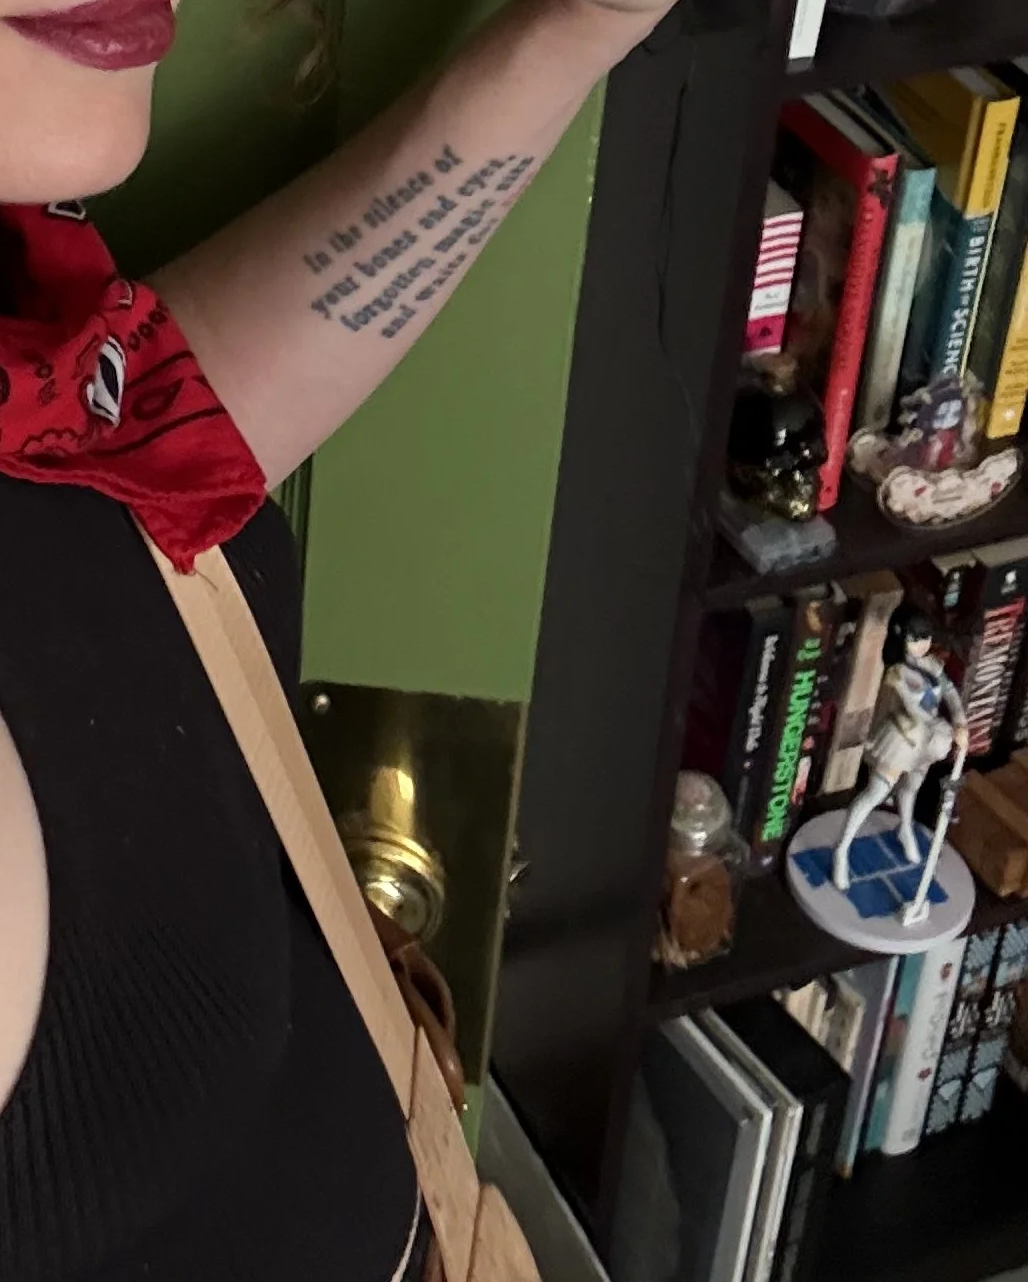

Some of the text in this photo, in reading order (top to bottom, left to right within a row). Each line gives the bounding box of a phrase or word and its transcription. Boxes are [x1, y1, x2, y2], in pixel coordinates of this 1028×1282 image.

[329, 224, 363, 254] the
[362, 170, 435, 229] silence
[434, 144, 463, 174] of
[310, 275, 361, 321] your
[352, 229, 418, 278] bones
[418, 194, 458, 230] and
[941, 307, 971, 375] SCIENC
